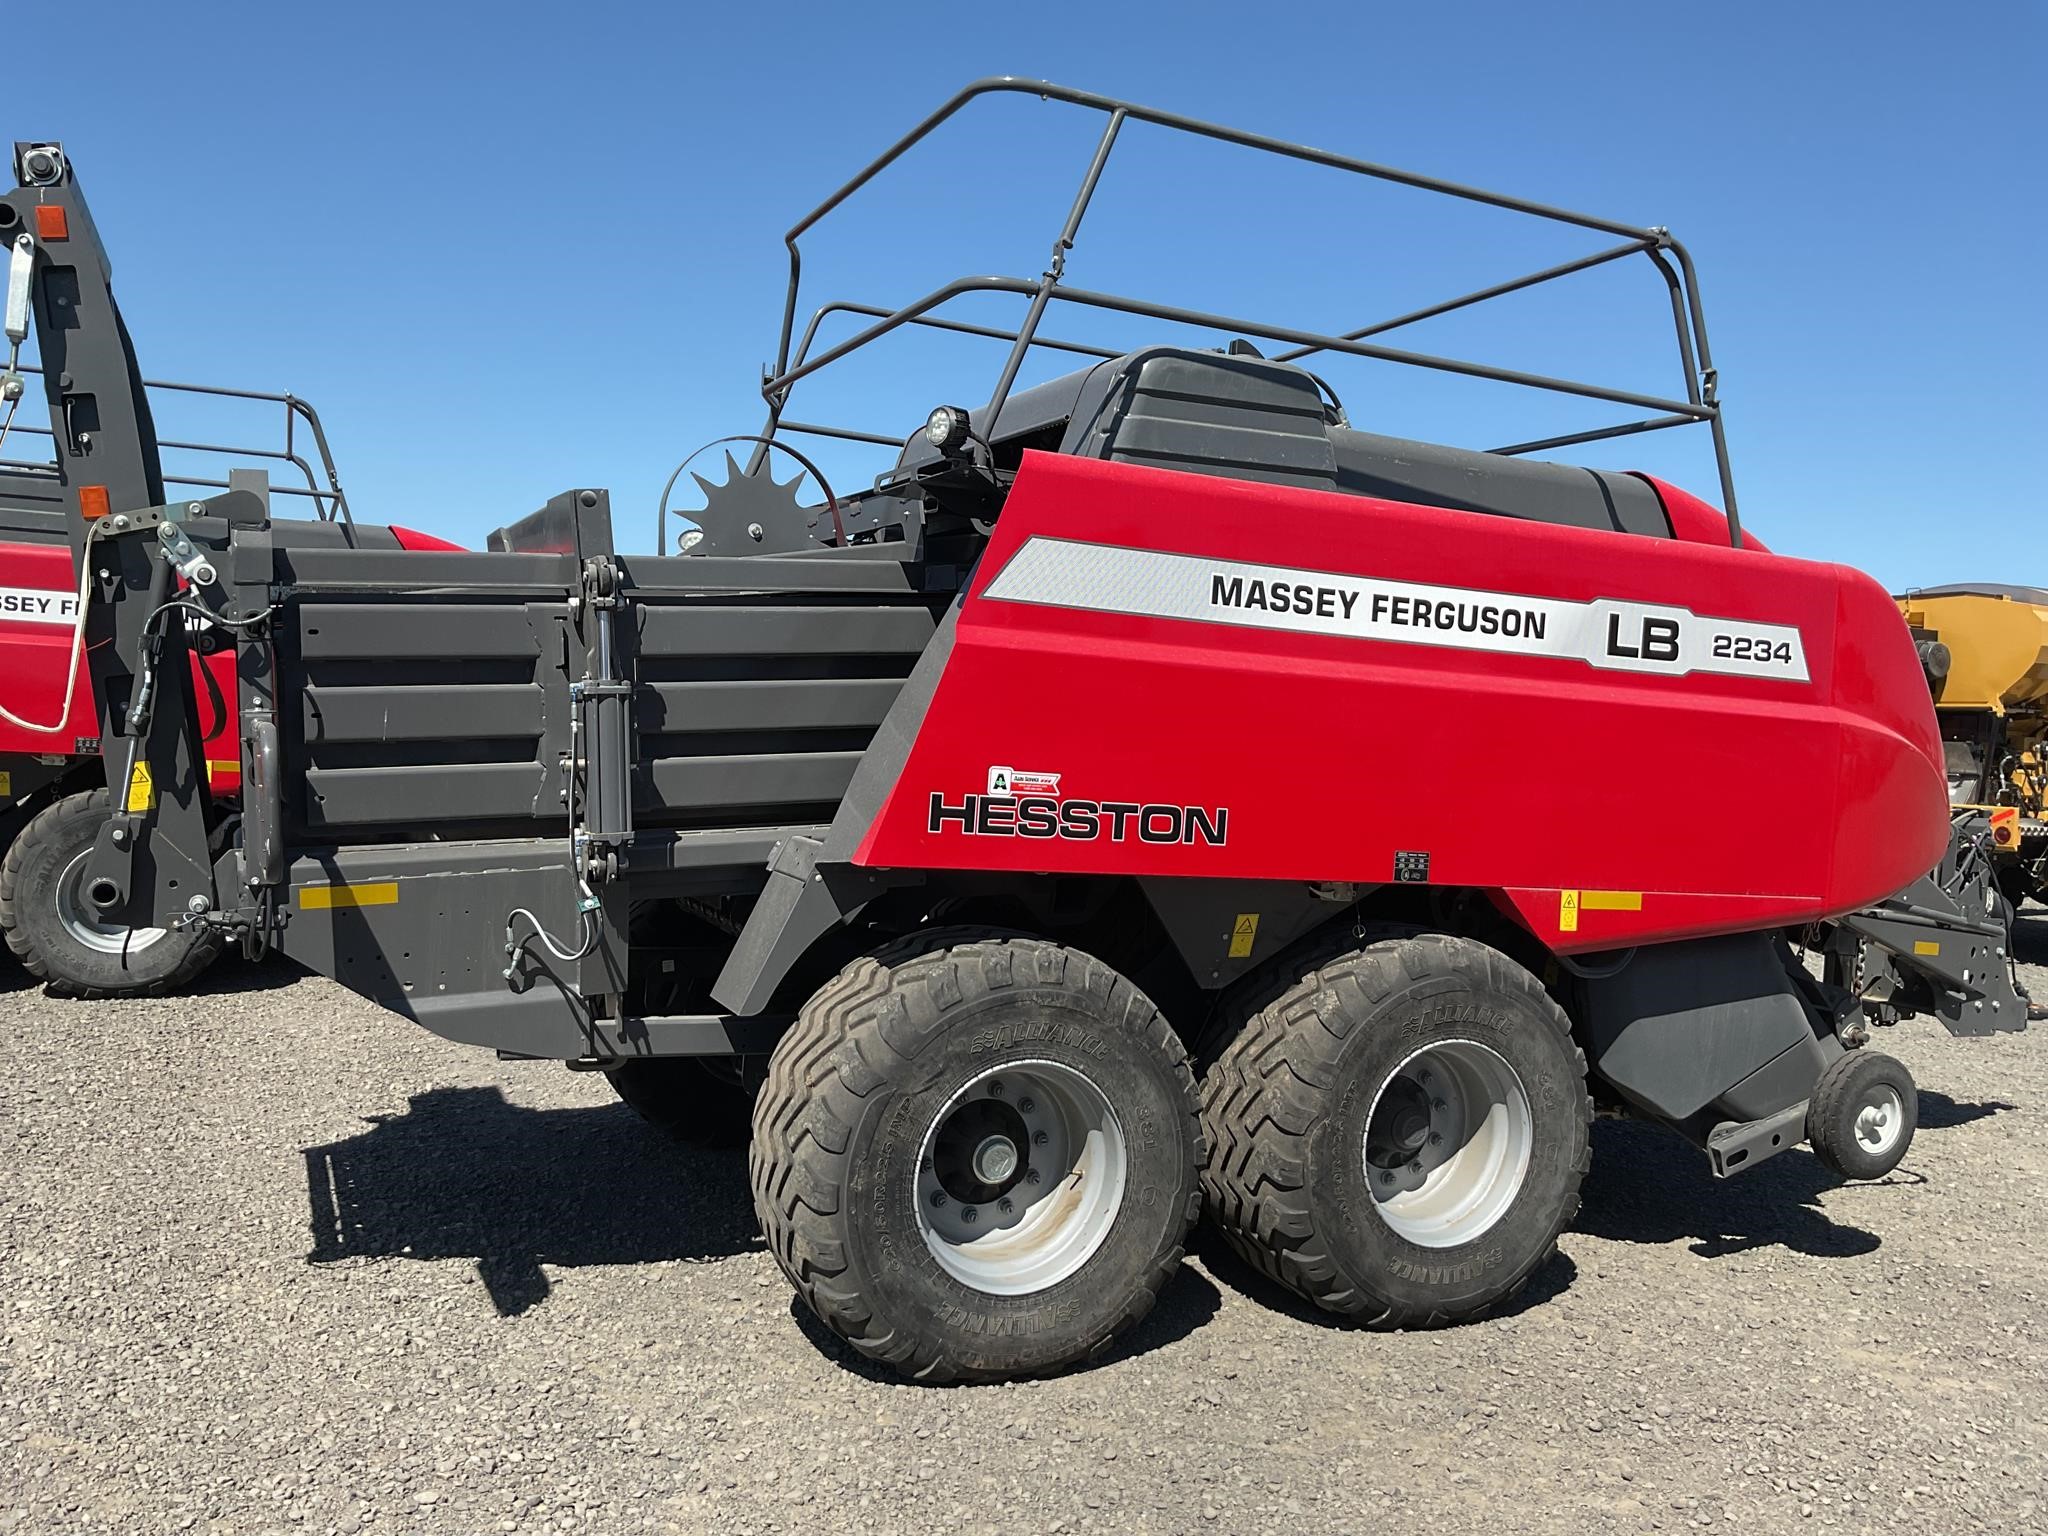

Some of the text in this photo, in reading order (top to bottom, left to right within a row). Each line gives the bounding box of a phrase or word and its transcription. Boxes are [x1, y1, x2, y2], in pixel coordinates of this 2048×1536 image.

[0, 593, 79, 617] SEY F
[1209, 574, 1792, 665] MASSEY FERGUSON LB 2234
[927, 791, 1229, 847] HESSTON
[1418, 1004, 1515, 1037] ALLIANCE
[993, 1023, 1111, 1061] ALLIANCE
[888, 1097, 913, 1138] IMP
[1385, 1252, 1484, 1285] ALLIANCE
[932, 1300, 1058, 1337] ALLIANCE
